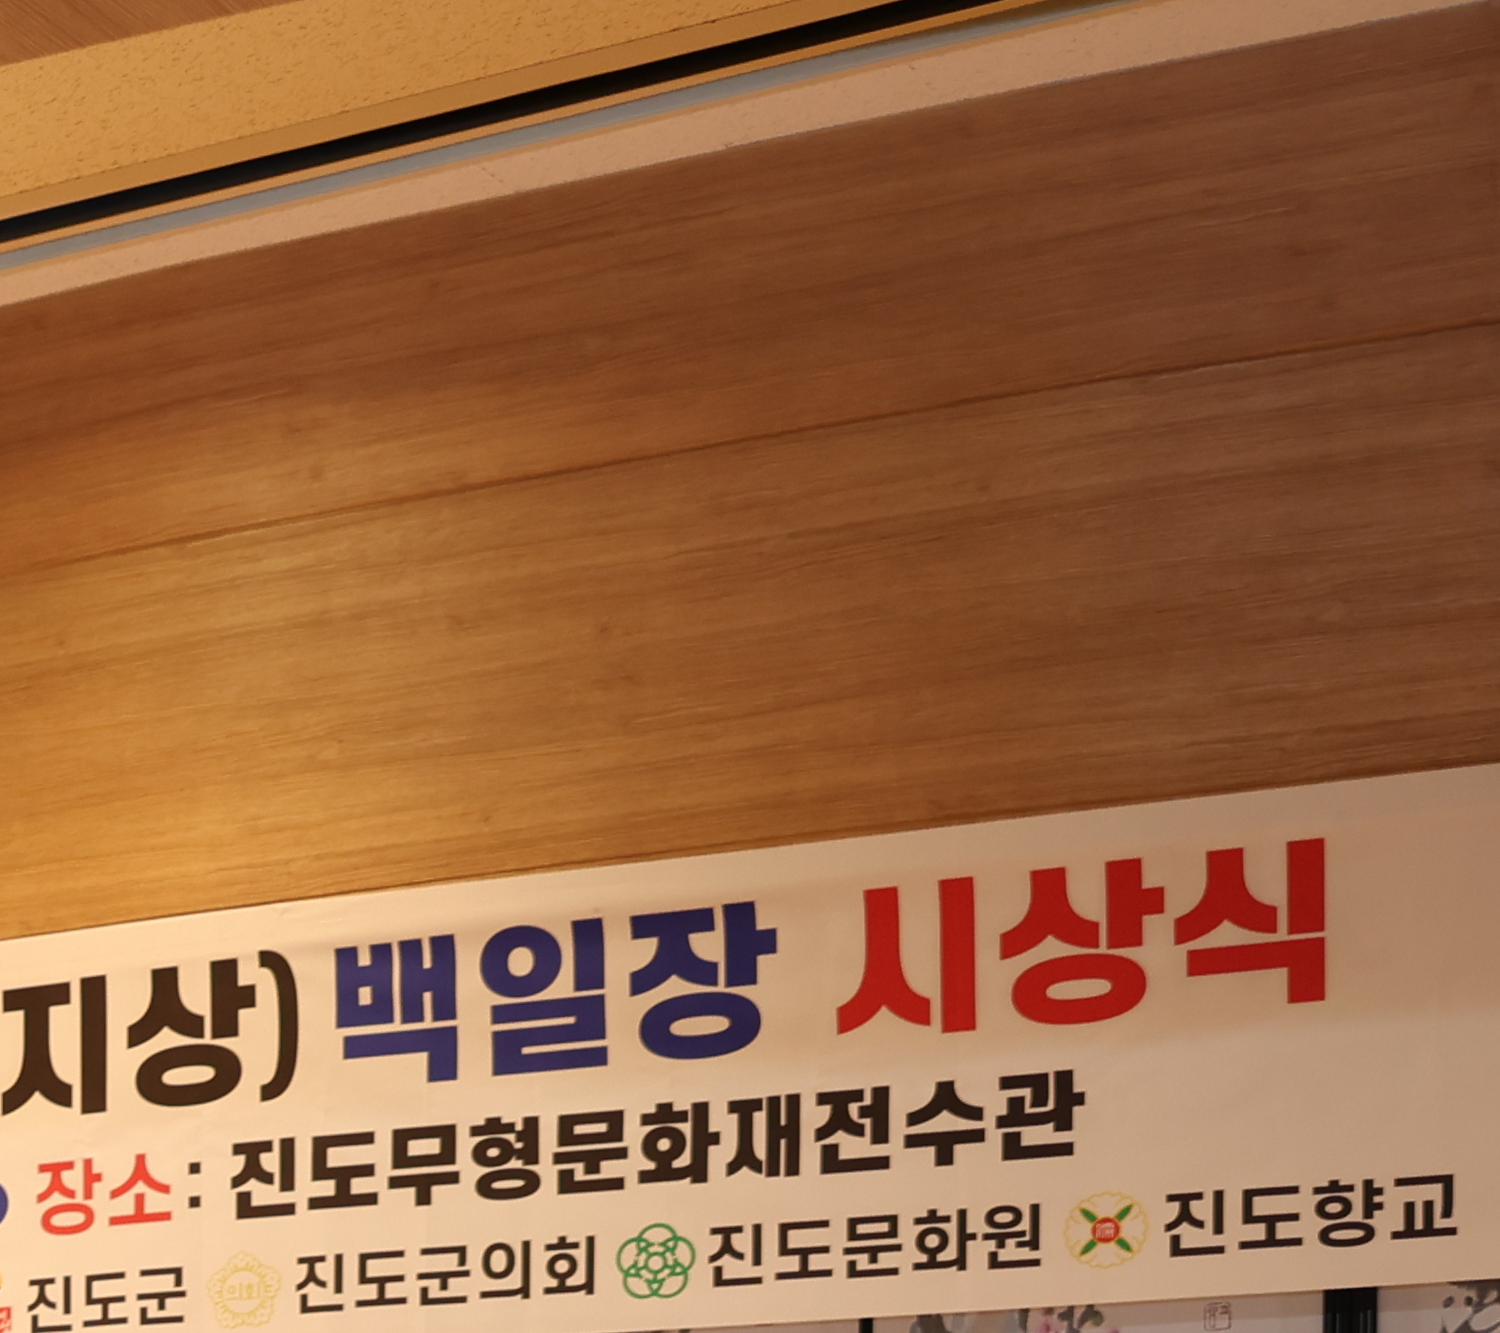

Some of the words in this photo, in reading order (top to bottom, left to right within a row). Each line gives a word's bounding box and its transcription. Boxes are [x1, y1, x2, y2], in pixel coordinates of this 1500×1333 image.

[333, 902, 777, 1082] 백일장
[835, 837, 1327, 1036] 시상식
[230, 1068, 1086, 1221] 진도무형문화재전수관
[706, 1203, 1042, 1288] 진도문화원
[1164, 1173, 1458, 1258] 진도향교
[26, 1266, 187, 1333] 진도군
[295, 1235, 597, 1315] 진도군의회
